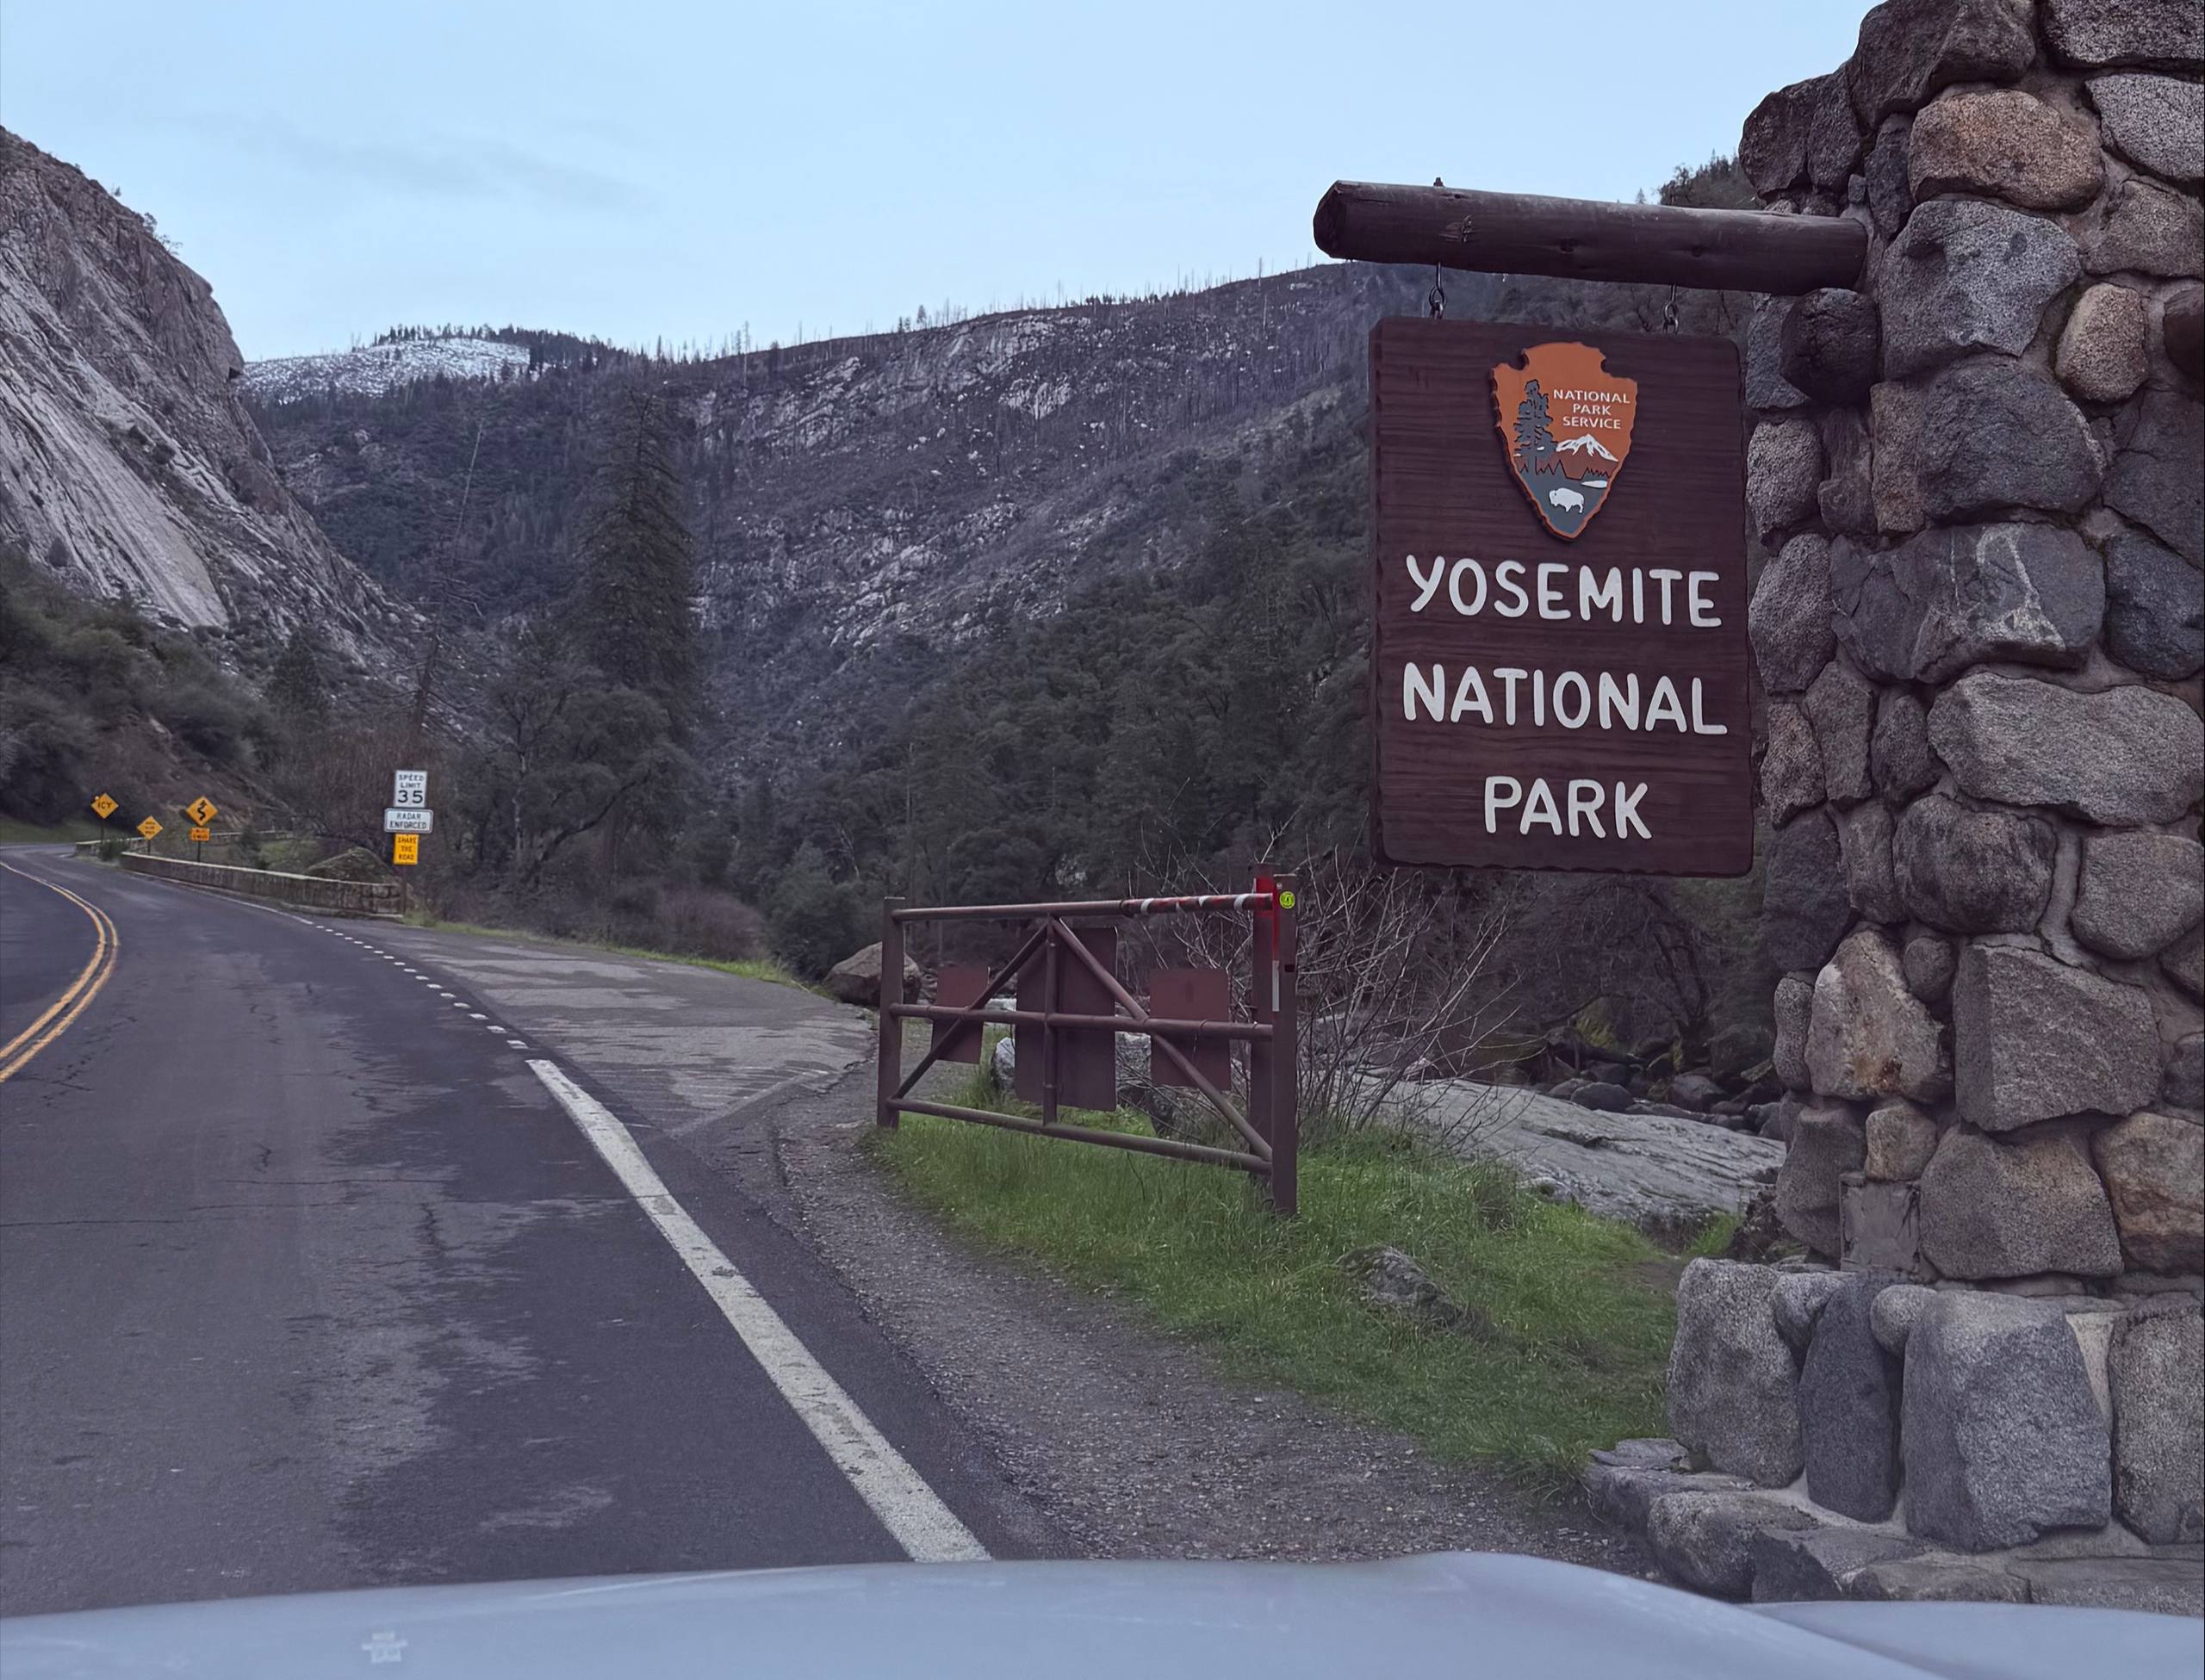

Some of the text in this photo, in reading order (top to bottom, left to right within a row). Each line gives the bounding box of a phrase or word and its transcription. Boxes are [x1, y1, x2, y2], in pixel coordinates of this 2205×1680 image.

[1553, 389, 1630, 404] NATIONAL
[1573, 404, 1612, 415] PARK
[1562, 416, 1622, 430] SERVICE
[1405, 554, 1724, 628] YOSEMITE
[1402, 661, 1729, 735] NATIONAL
[398, 790, 423, 803] 35
[97, 801, 113, 809] ICY
[1484, 775, 1653, 840] PARK
[389, 821, 427, 829] ENFORCED
